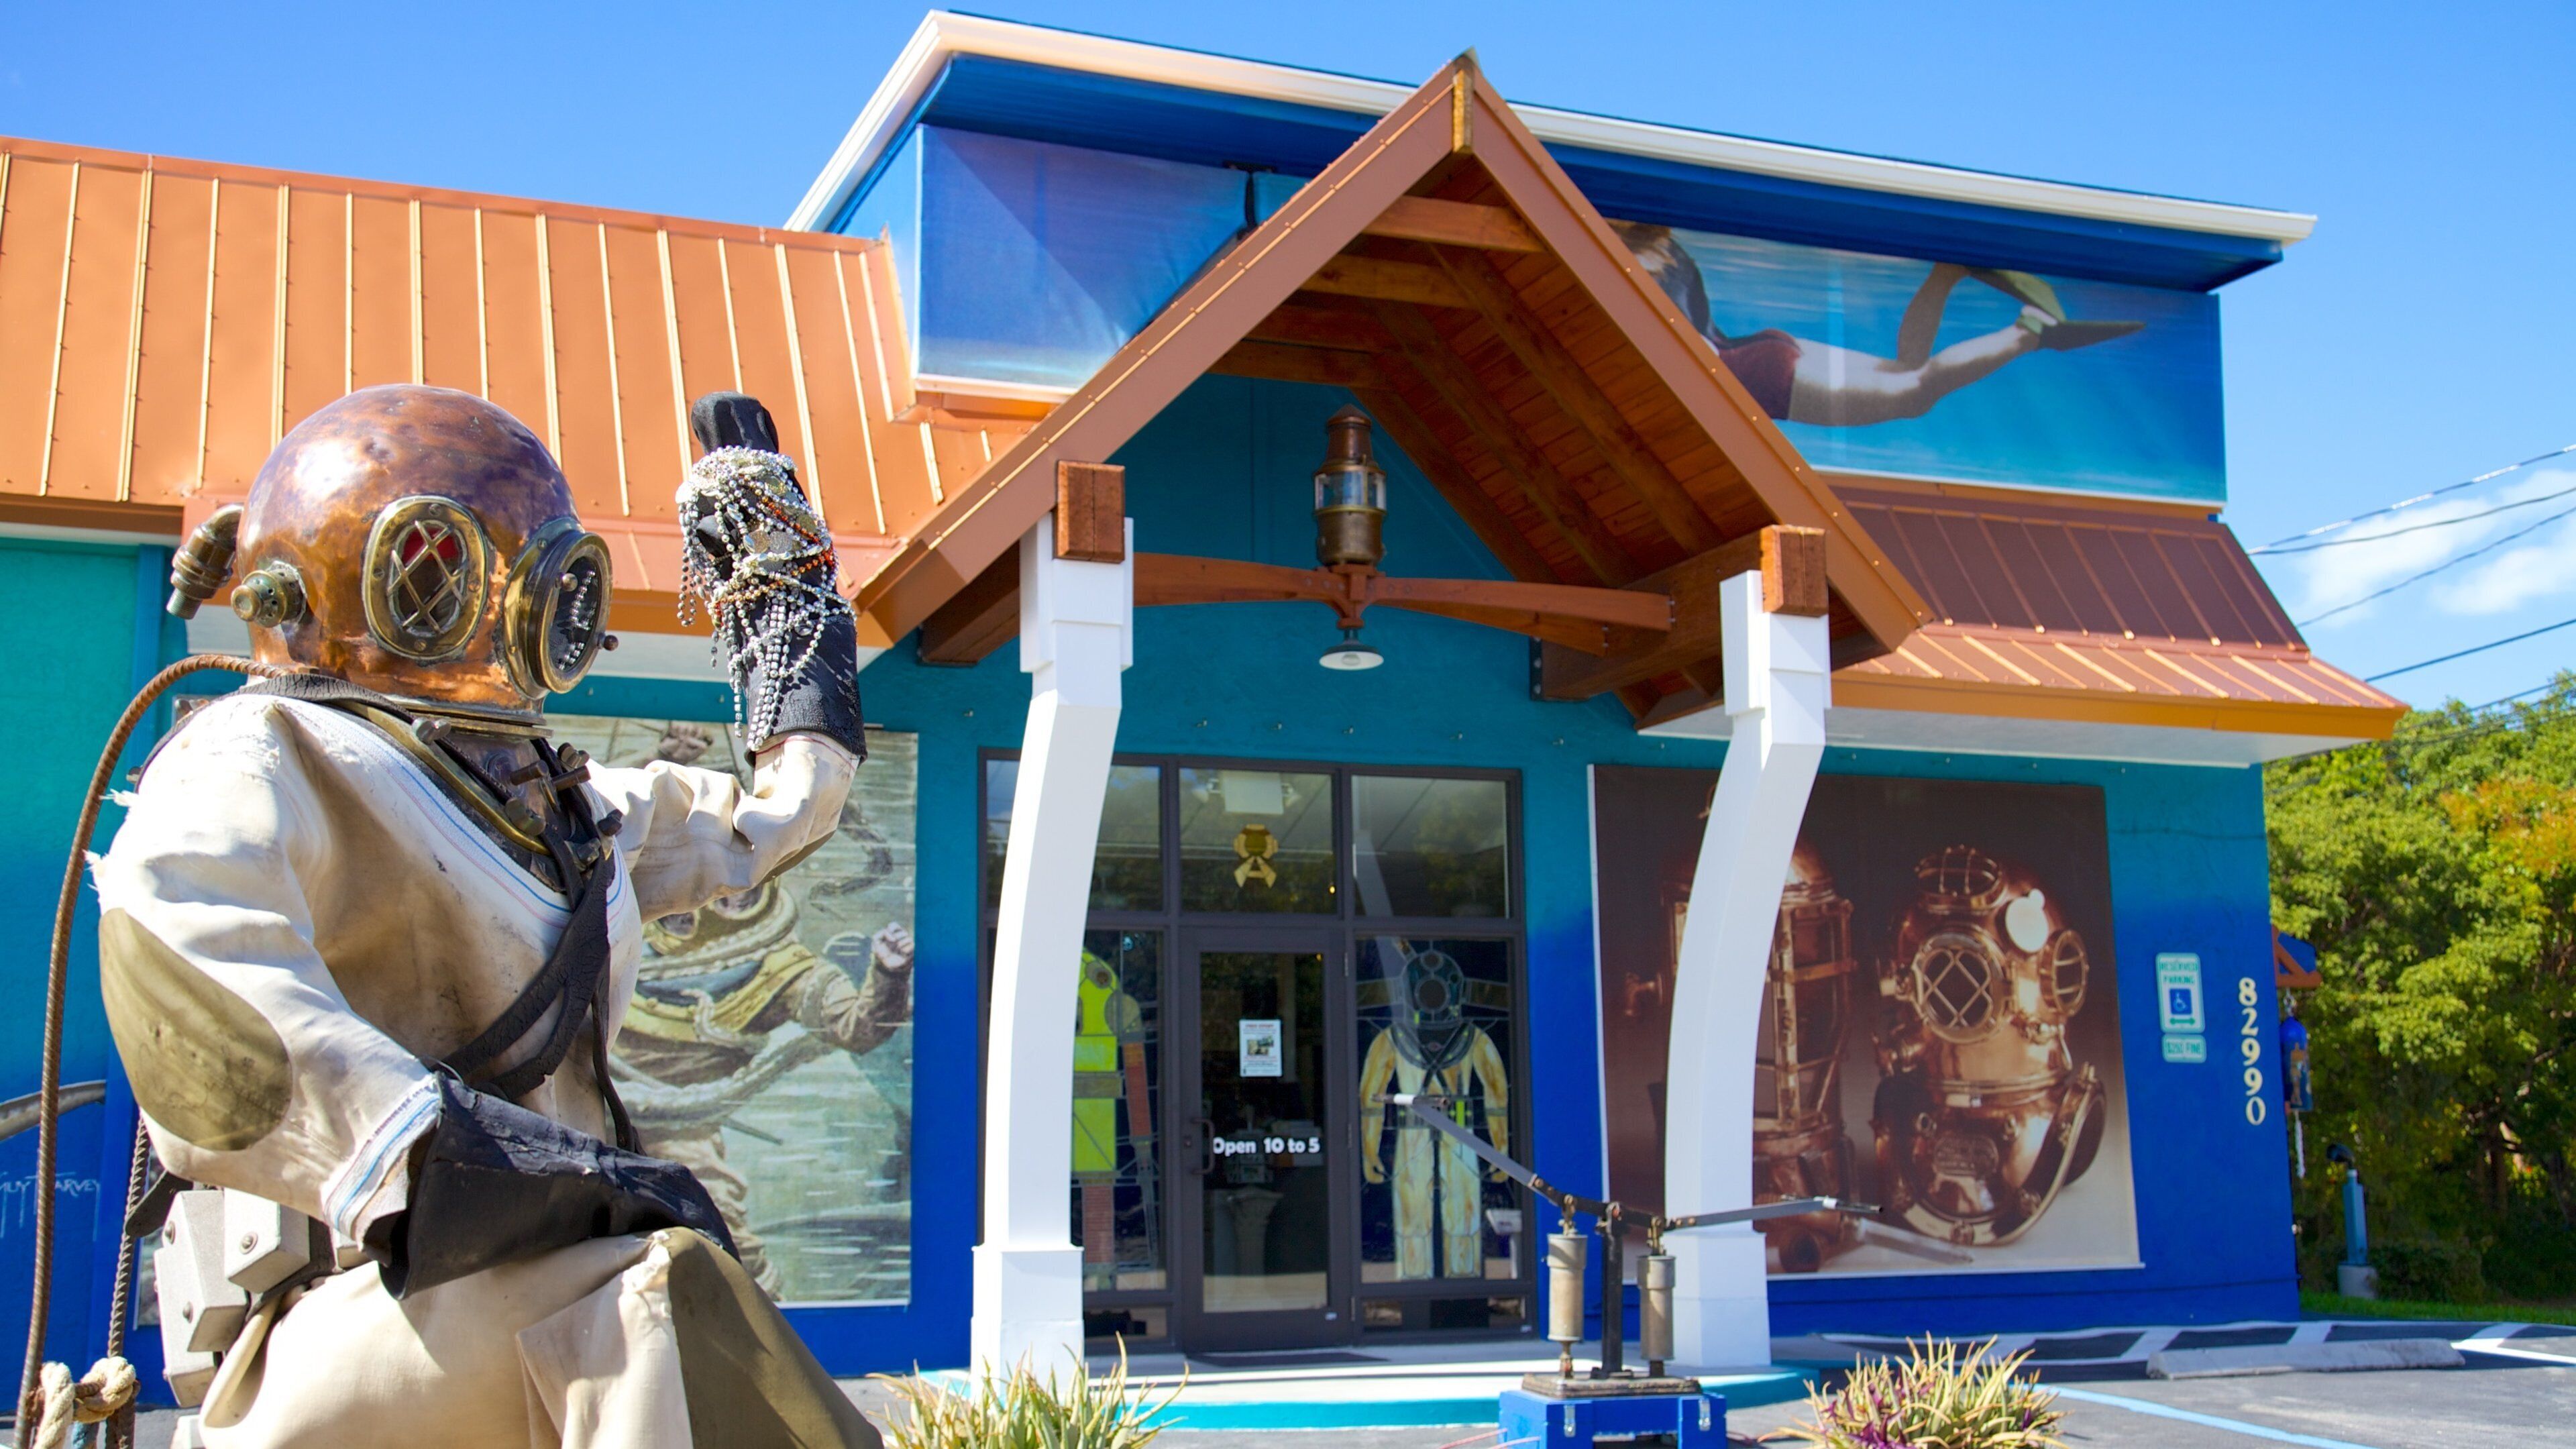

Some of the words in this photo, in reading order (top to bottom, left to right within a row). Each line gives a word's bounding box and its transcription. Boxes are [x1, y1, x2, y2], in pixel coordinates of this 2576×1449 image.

[2159, 961, 2198, 971] RESERVED
[2163, 976, 2195, 984] PARKING
[2186, 1042, 2202, 1055] FINE
[2238, 977, 2266, 1126] 82990
[1212, 1136, 1256, 1157] Open
[1263, 1137, 1284, 1153] 10
[1287, 1138, 1305, 1153] to
[1308, 1137, 1320, 1153] 5
